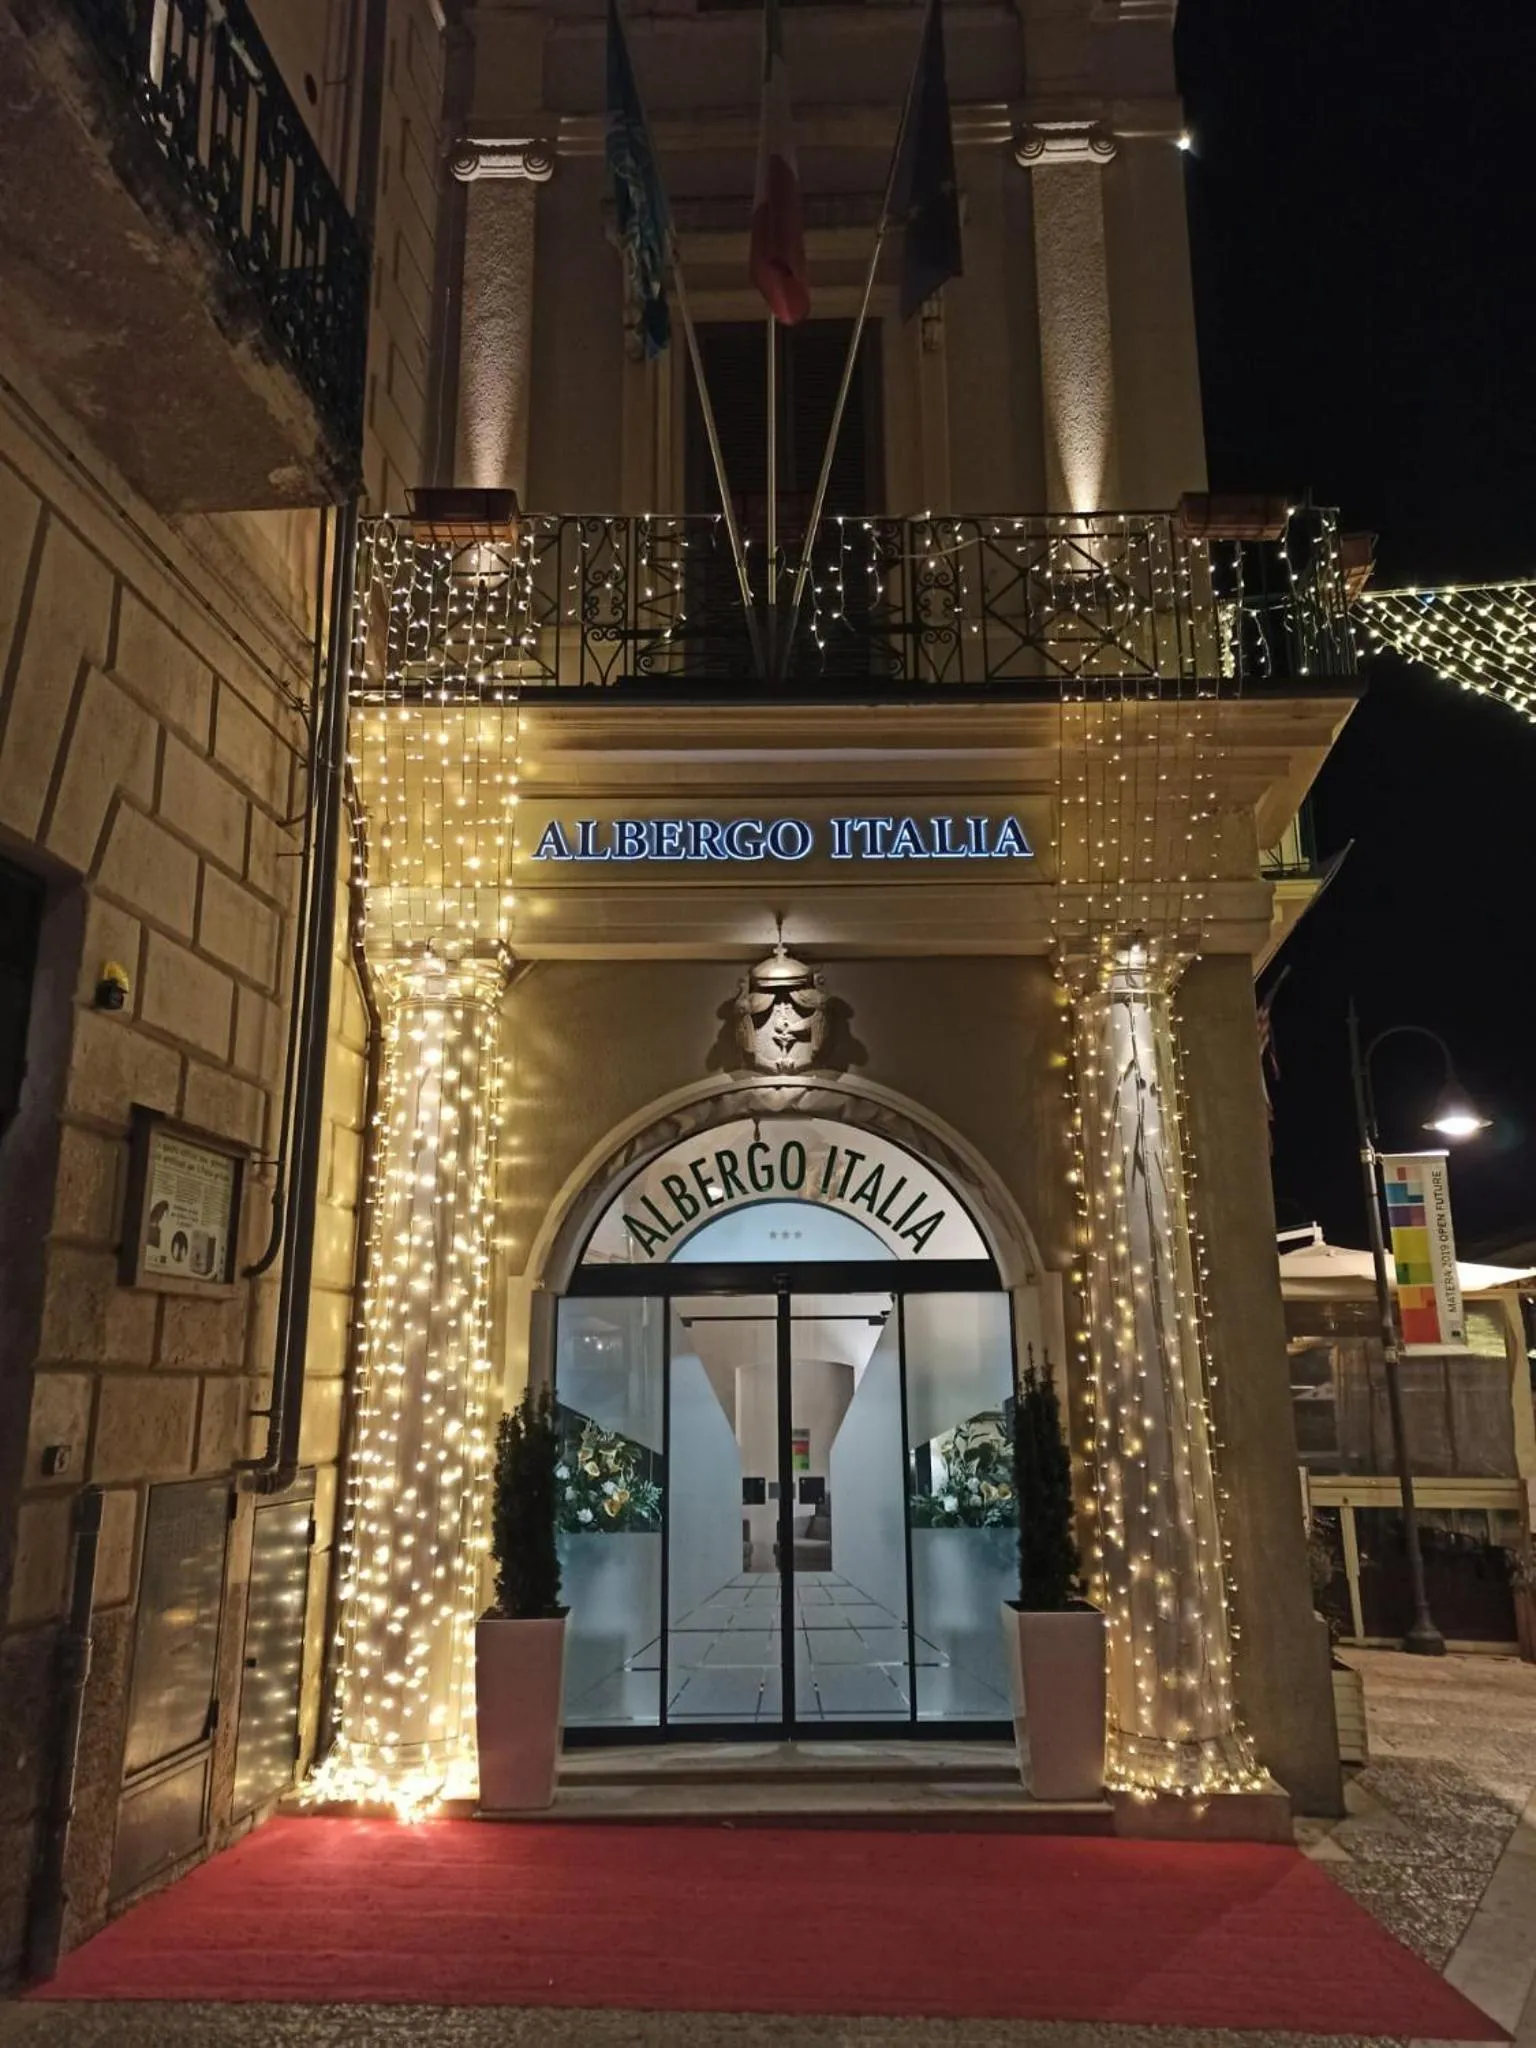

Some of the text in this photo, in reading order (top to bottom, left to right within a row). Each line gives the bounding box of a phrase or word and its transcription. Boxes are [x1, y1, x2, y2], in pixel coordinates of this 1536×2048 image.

[531, 816, 1034, 861] ALBERGO ITALIA
[621, 1140, 946, 1258] ALBERGO ITALIA
[1431, 1170, 1457, 1313] MATERA 2019 OPEN FUTURE
